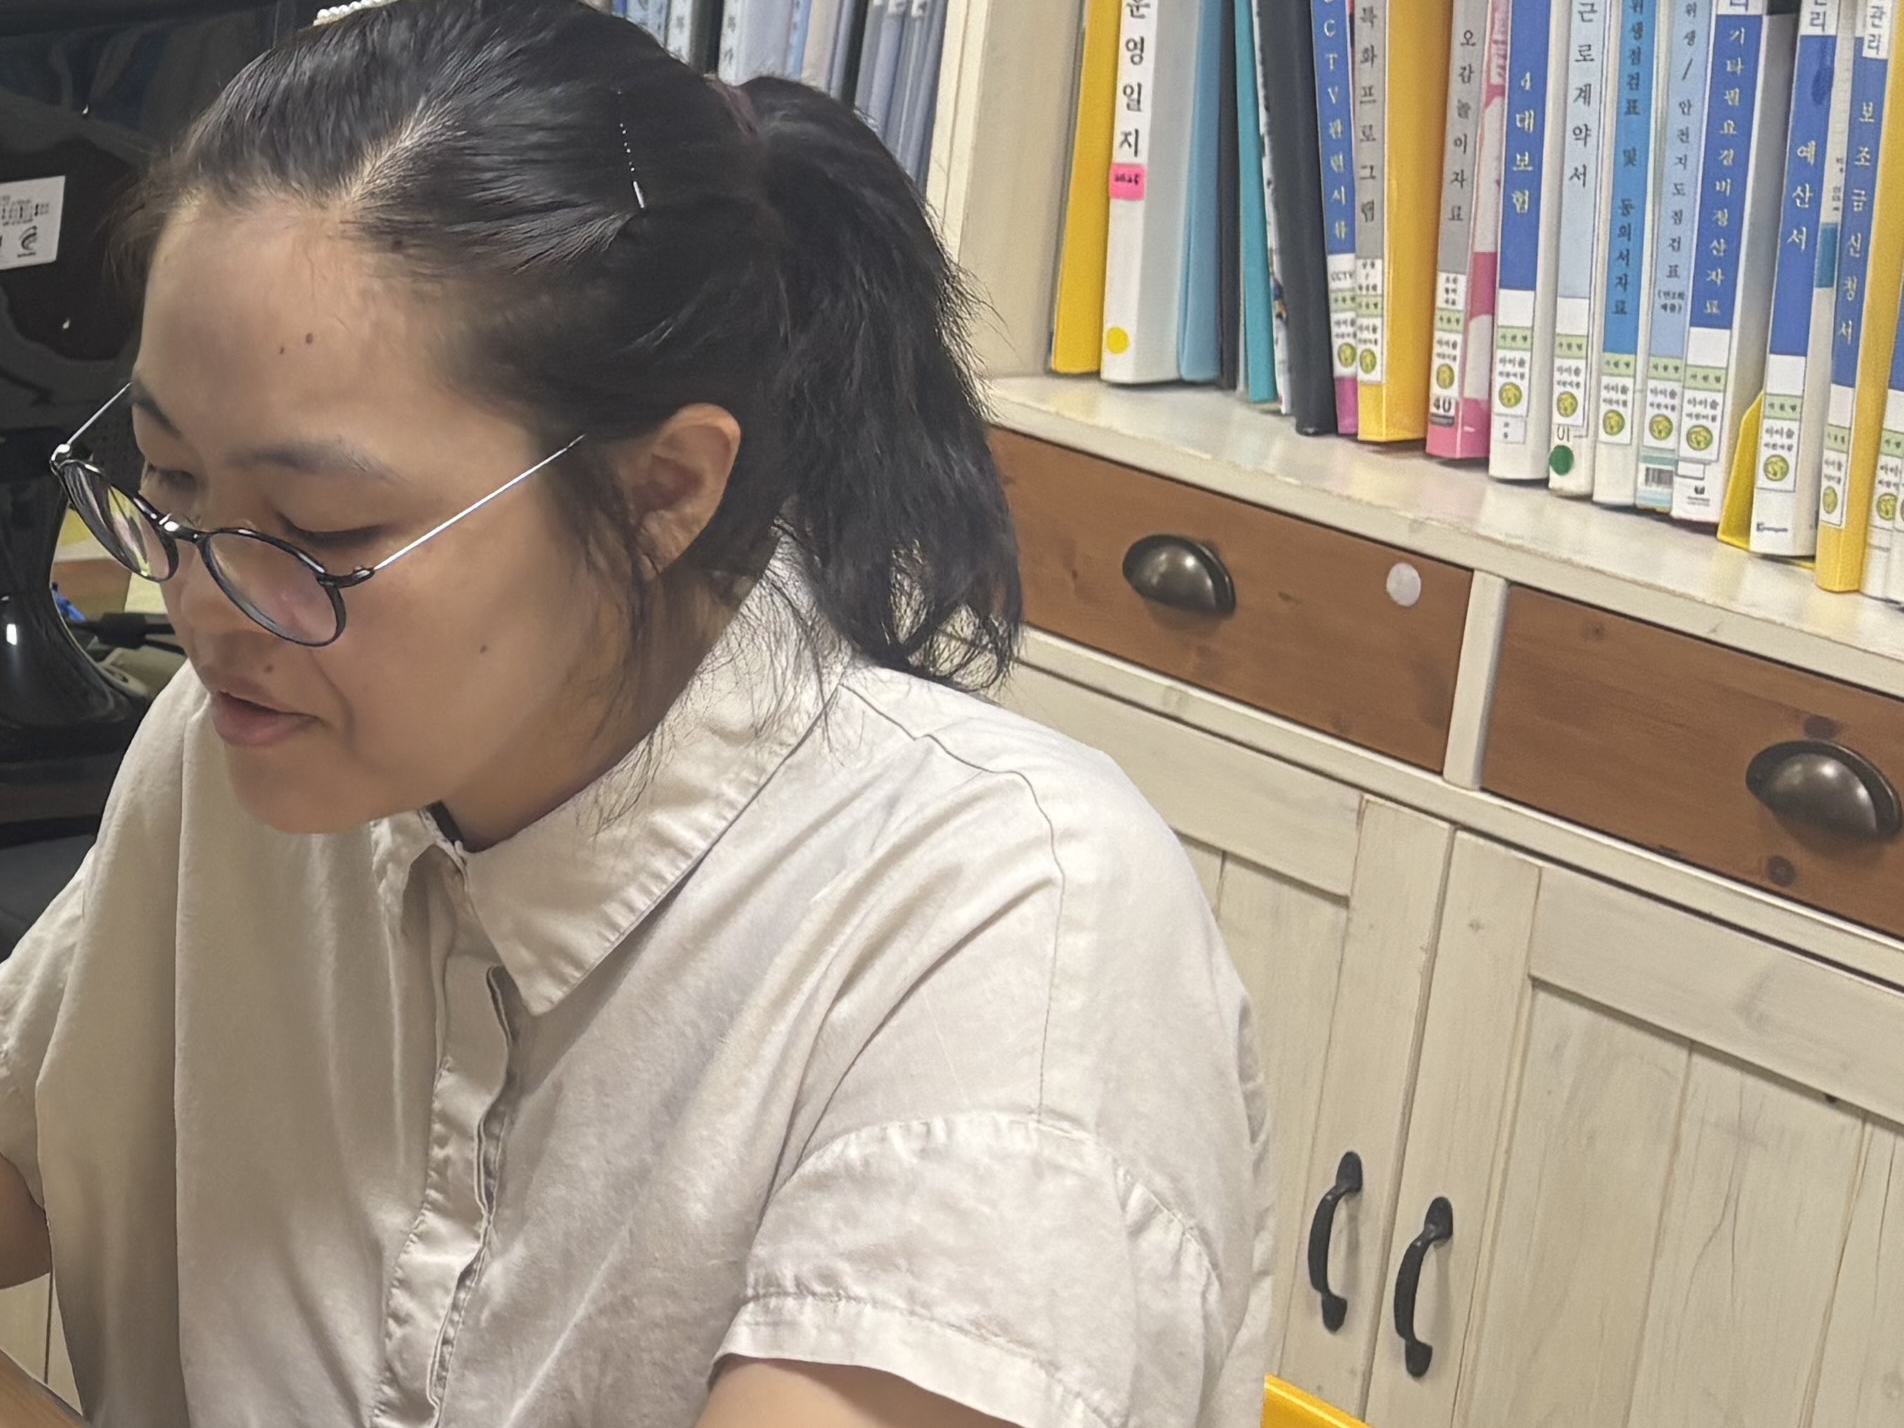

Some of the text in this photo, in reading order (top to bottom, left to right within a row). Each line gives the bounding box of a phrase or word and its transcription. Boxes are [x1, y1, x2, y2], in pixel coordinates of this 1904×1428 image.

[1359, 4, 1378, 224] 특화프로그램
[1448, 30, 1478, 222] 오감놀이자료
[1512, 72, 1536, 214] 4대보험
[1569, 2, 1599, 188] 근로계약서
[1623, 147, 1638, 168] 및
[1786, 139, 1818, 254] 예산서
